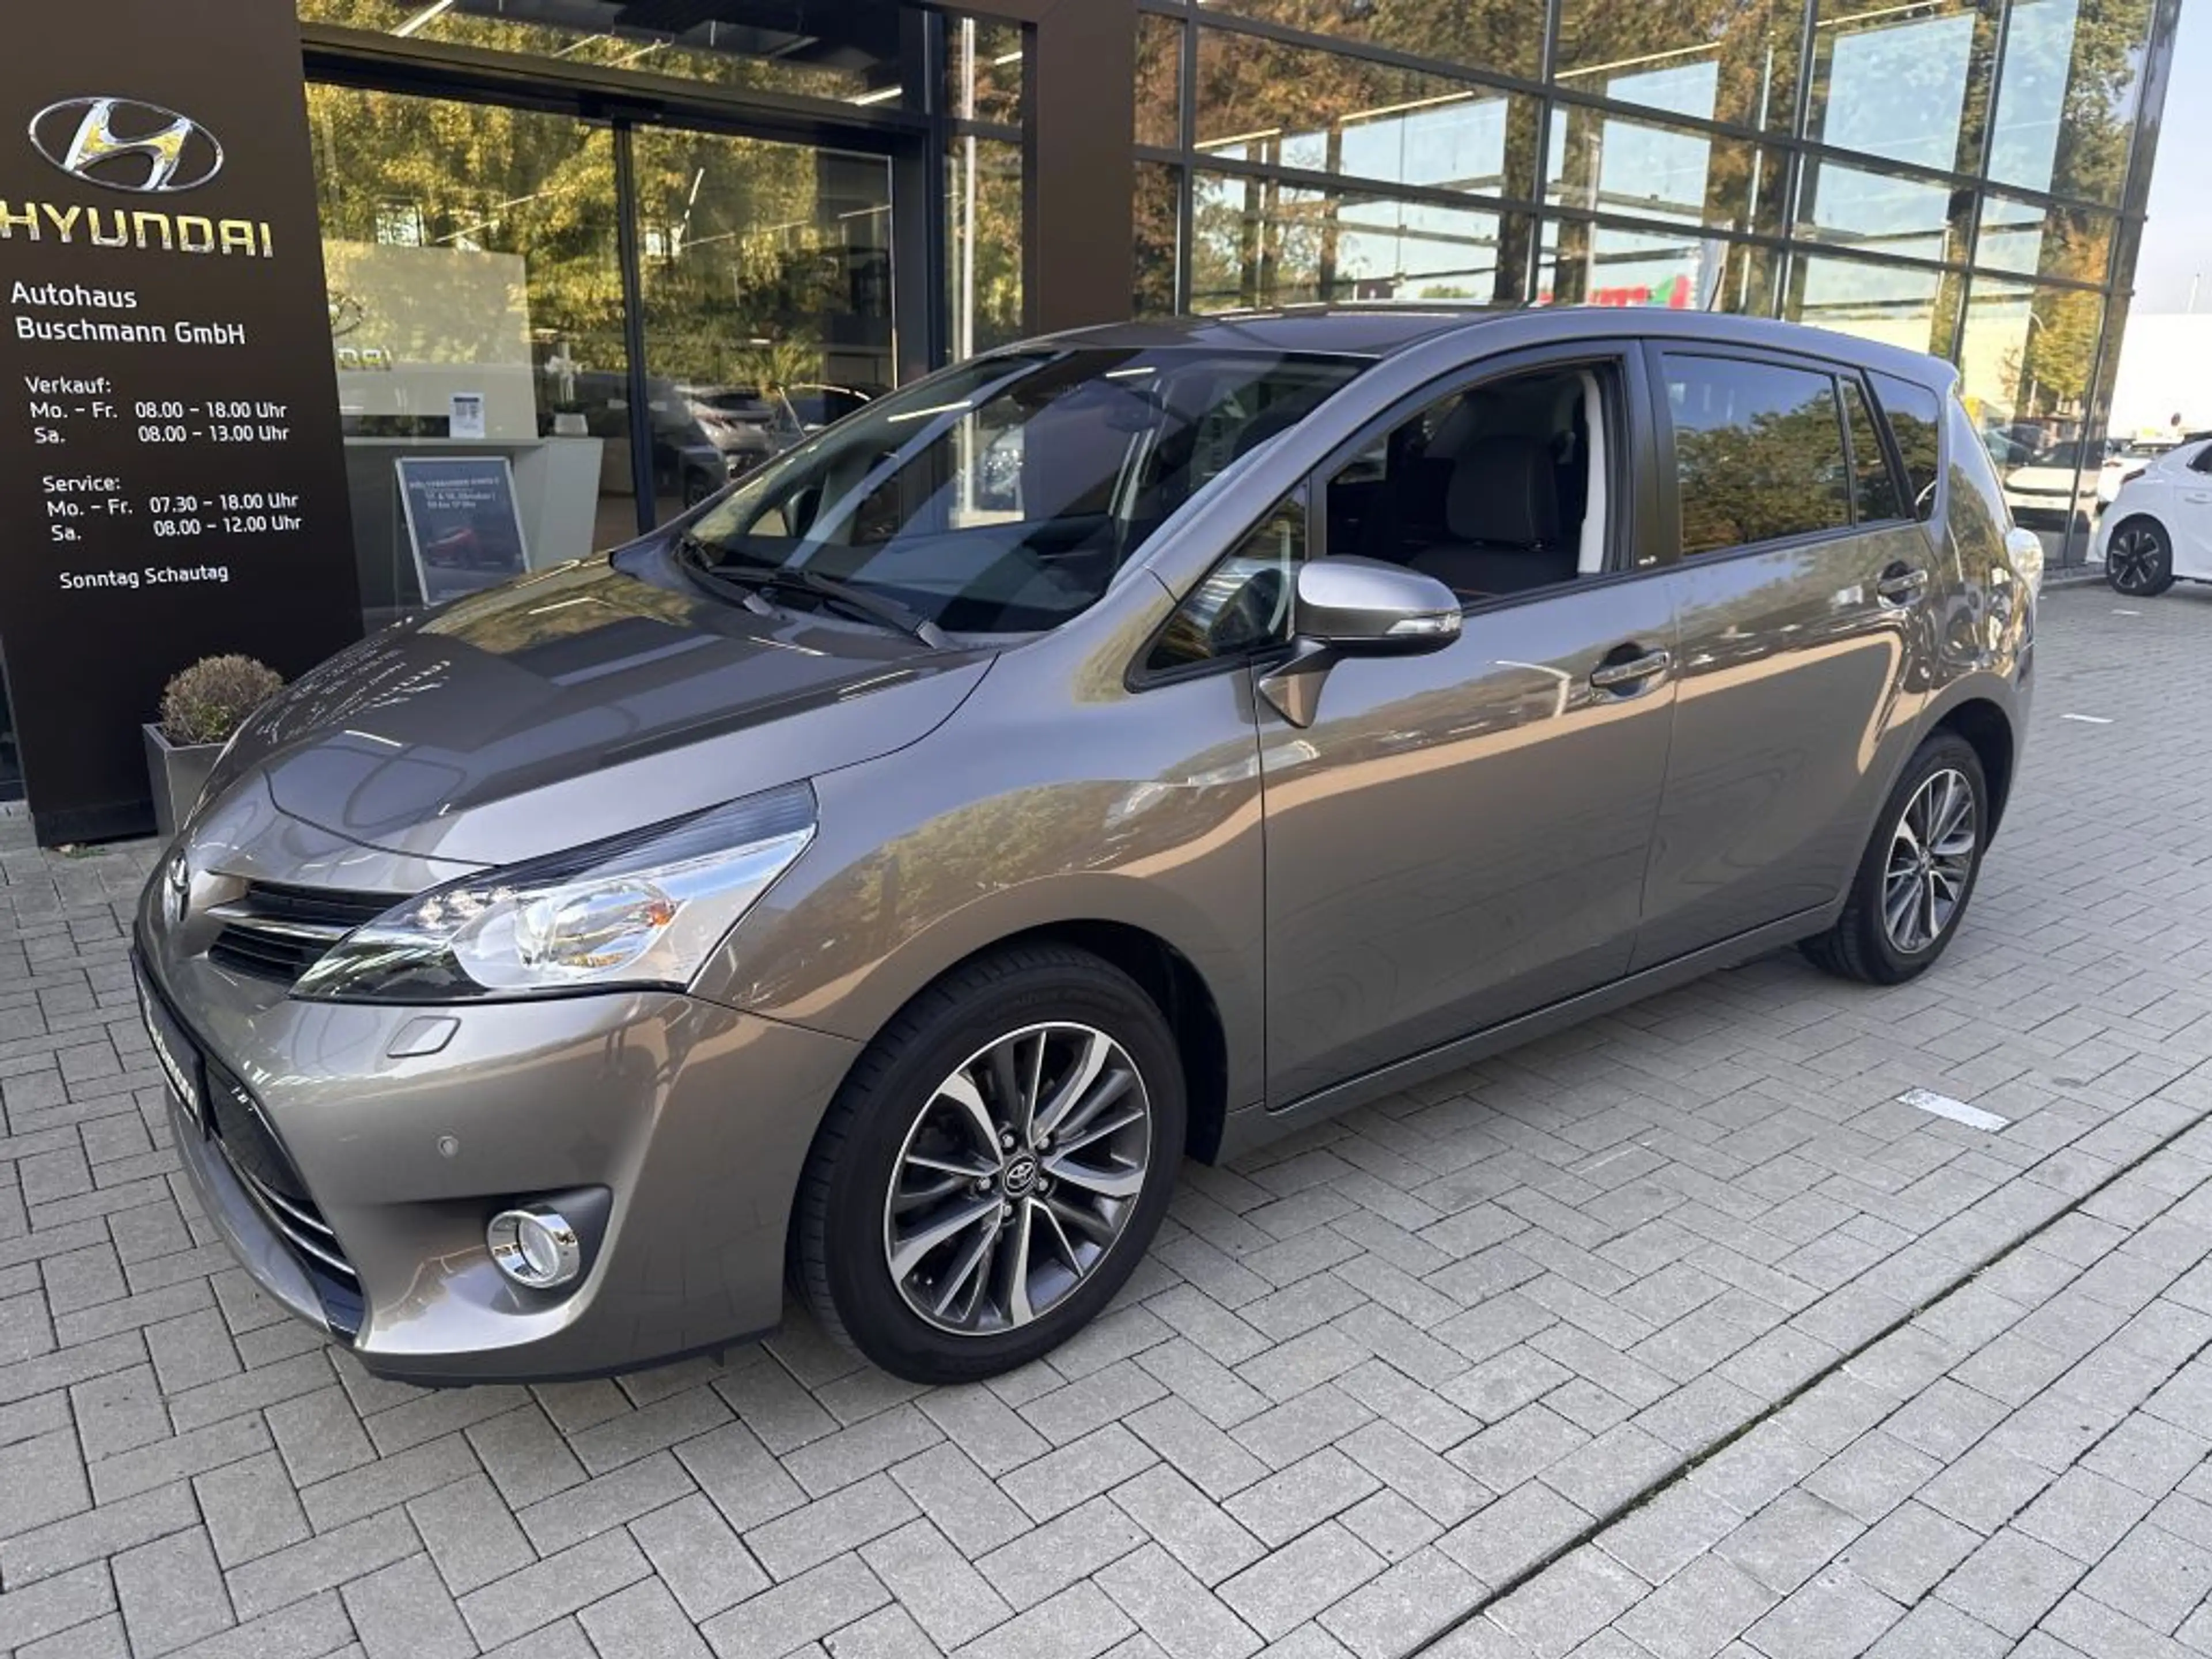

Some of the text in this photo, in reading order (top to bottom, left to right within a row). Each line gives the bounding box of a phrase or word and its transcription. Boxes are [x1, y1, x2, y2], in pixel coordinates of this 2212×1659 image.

[0, 200, 272, 257] HYUNDAI
[11, 281, 137, 308] Autohaus
[16, 316, 245, 344] Buschmann GmbH
[25, 376, 111, 394] Verkauf:
[30, 402, 68, 418] Mo.
[92, 402, 118, 418] Fr.
[135, 402, 183, 418] 08.00
[206, 402, 252, 418] 18.00
[256, 402, 287, 418] Uhr
[34, 427, 66, 444] Sa.
[138, 425, 187, 442] 08.00
[209, 425, 254, 442] 13.00
[258, 425, 289, 441] Uhr
[43, 475, 120, 493] Service:
[47, 501, 84, 517] Mo.
[108, 498, 133, 514] Fr.
[149, 495, 198, 513] 07.30
[219, 493, 263, 510] 18.00
[267, 493, 298, 509] Uhr
[51, 524, 81, 541] Sa.
[153, 518, 202, 537] 08.00
[223, 516, 267, 533] 12.00
[271, 516, 302, 531] Uhr
[60, 565, 229, 589] Sonntag Schautag
